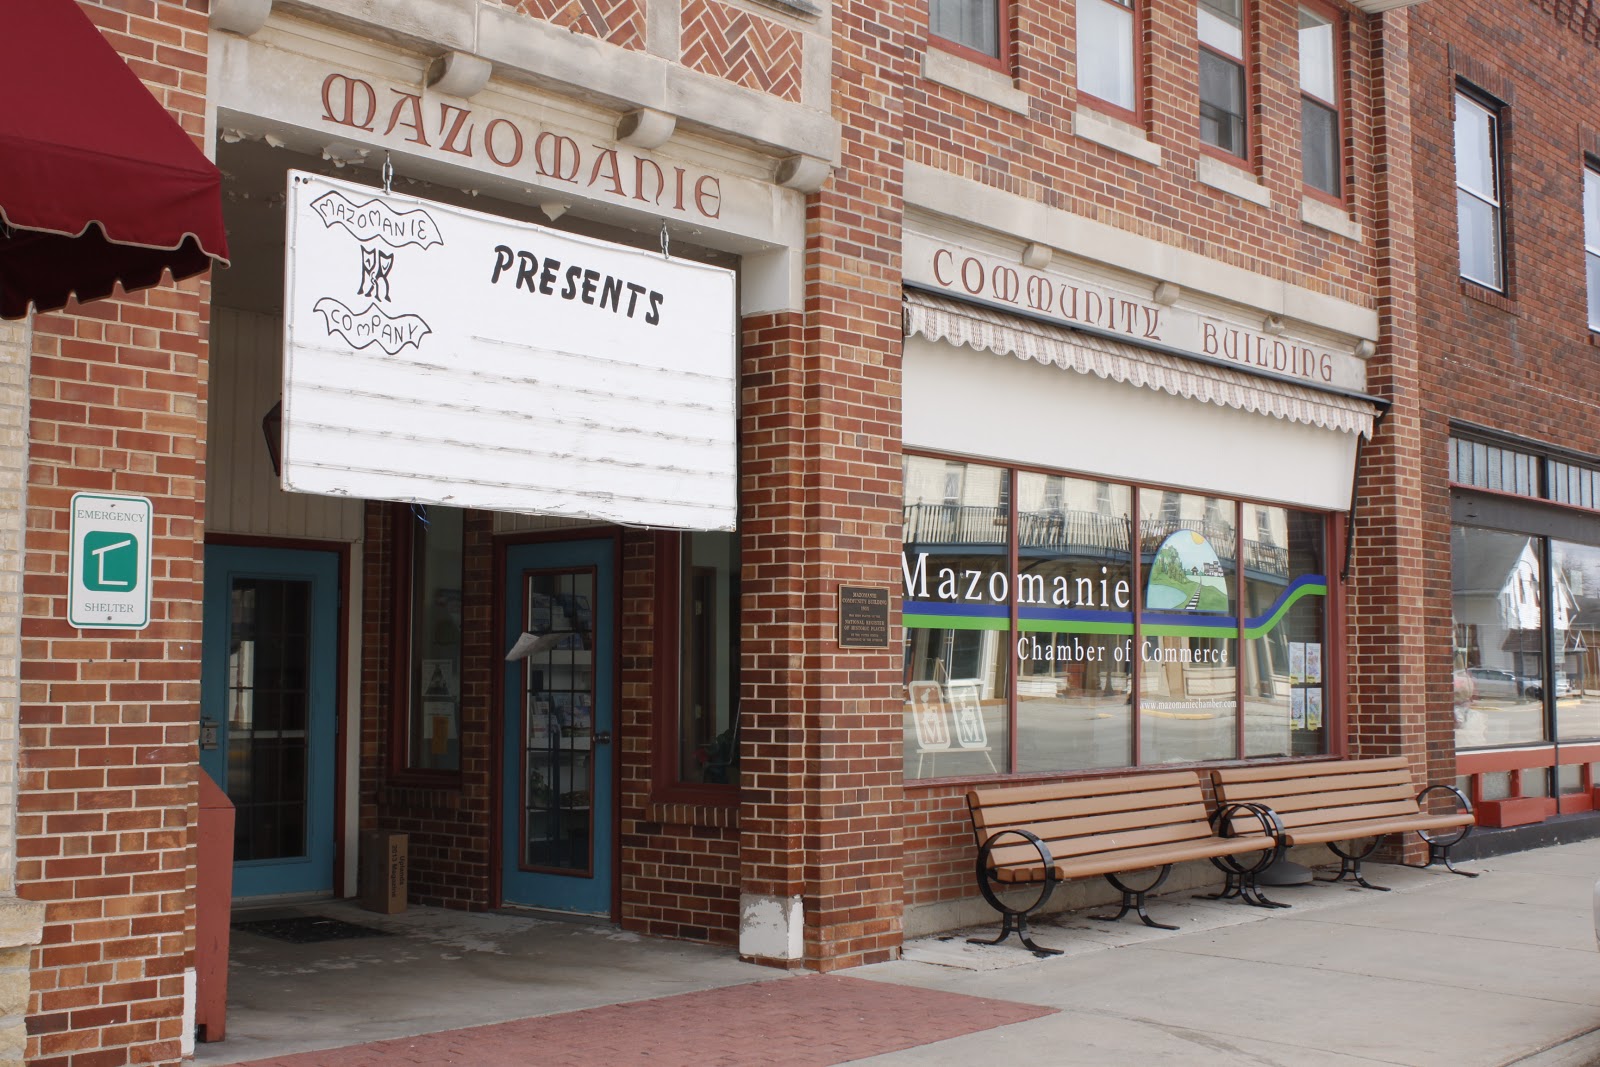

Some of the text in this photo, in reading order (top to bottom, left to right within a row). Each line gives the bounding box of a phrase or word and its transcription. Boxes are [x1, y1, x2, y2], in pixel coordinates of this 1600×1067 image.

[320, 73, 722, 219] MAZOMANIE
[319, 199, 427, 240] MAZOMANIE
[491, 244, 664, 326] PRESENTS
[331, 309, 418, 344] COMPANY
[933, 248, 1333, 382] COMMUNITY BUILDING
[77, 509, 145, 523] EMERGENCY
[902, 551, 1130, 609] Mazomanie
[84, 602, 134, 613] SHELTER
[1017, 636, 1228, 663] Chamber of Commerce
